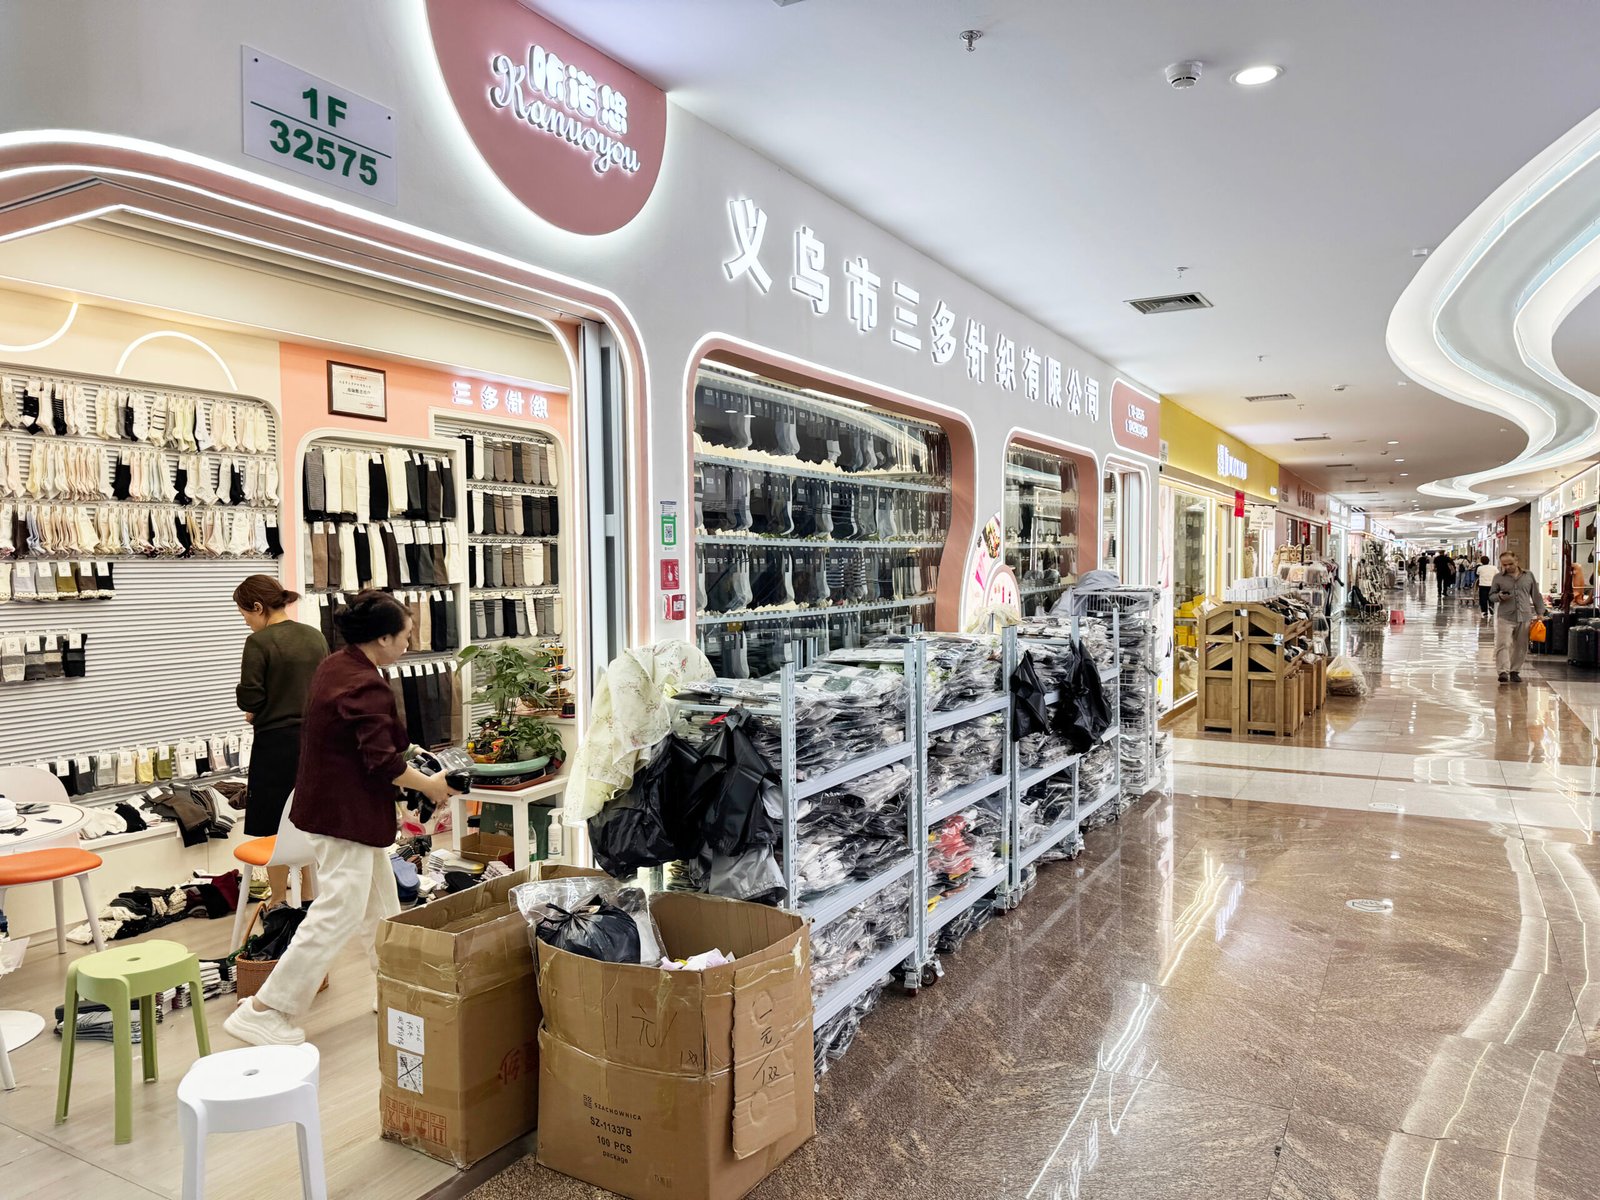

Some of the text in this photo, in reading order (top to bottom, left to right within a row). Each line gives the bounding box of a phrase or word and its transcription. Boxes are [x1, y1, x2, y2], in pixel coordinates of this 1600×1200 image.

[302, 87, 347, 128] 1F
[489, 53, 641, 174] Kanuoyou
[269, 119, 378, 187] 32575
[723, 196, 1101, 422] 义乌市三多针织有限公司
[451, 379, 550, 419] 三多针织
[590, 1115, 633, 1137] SZ-11337B
[594, 1102, 642, 1121] SZACHOWNICA
[596, 1135, 633, 1154] 100 PCS
[602, 1150, 629, 1164] package
